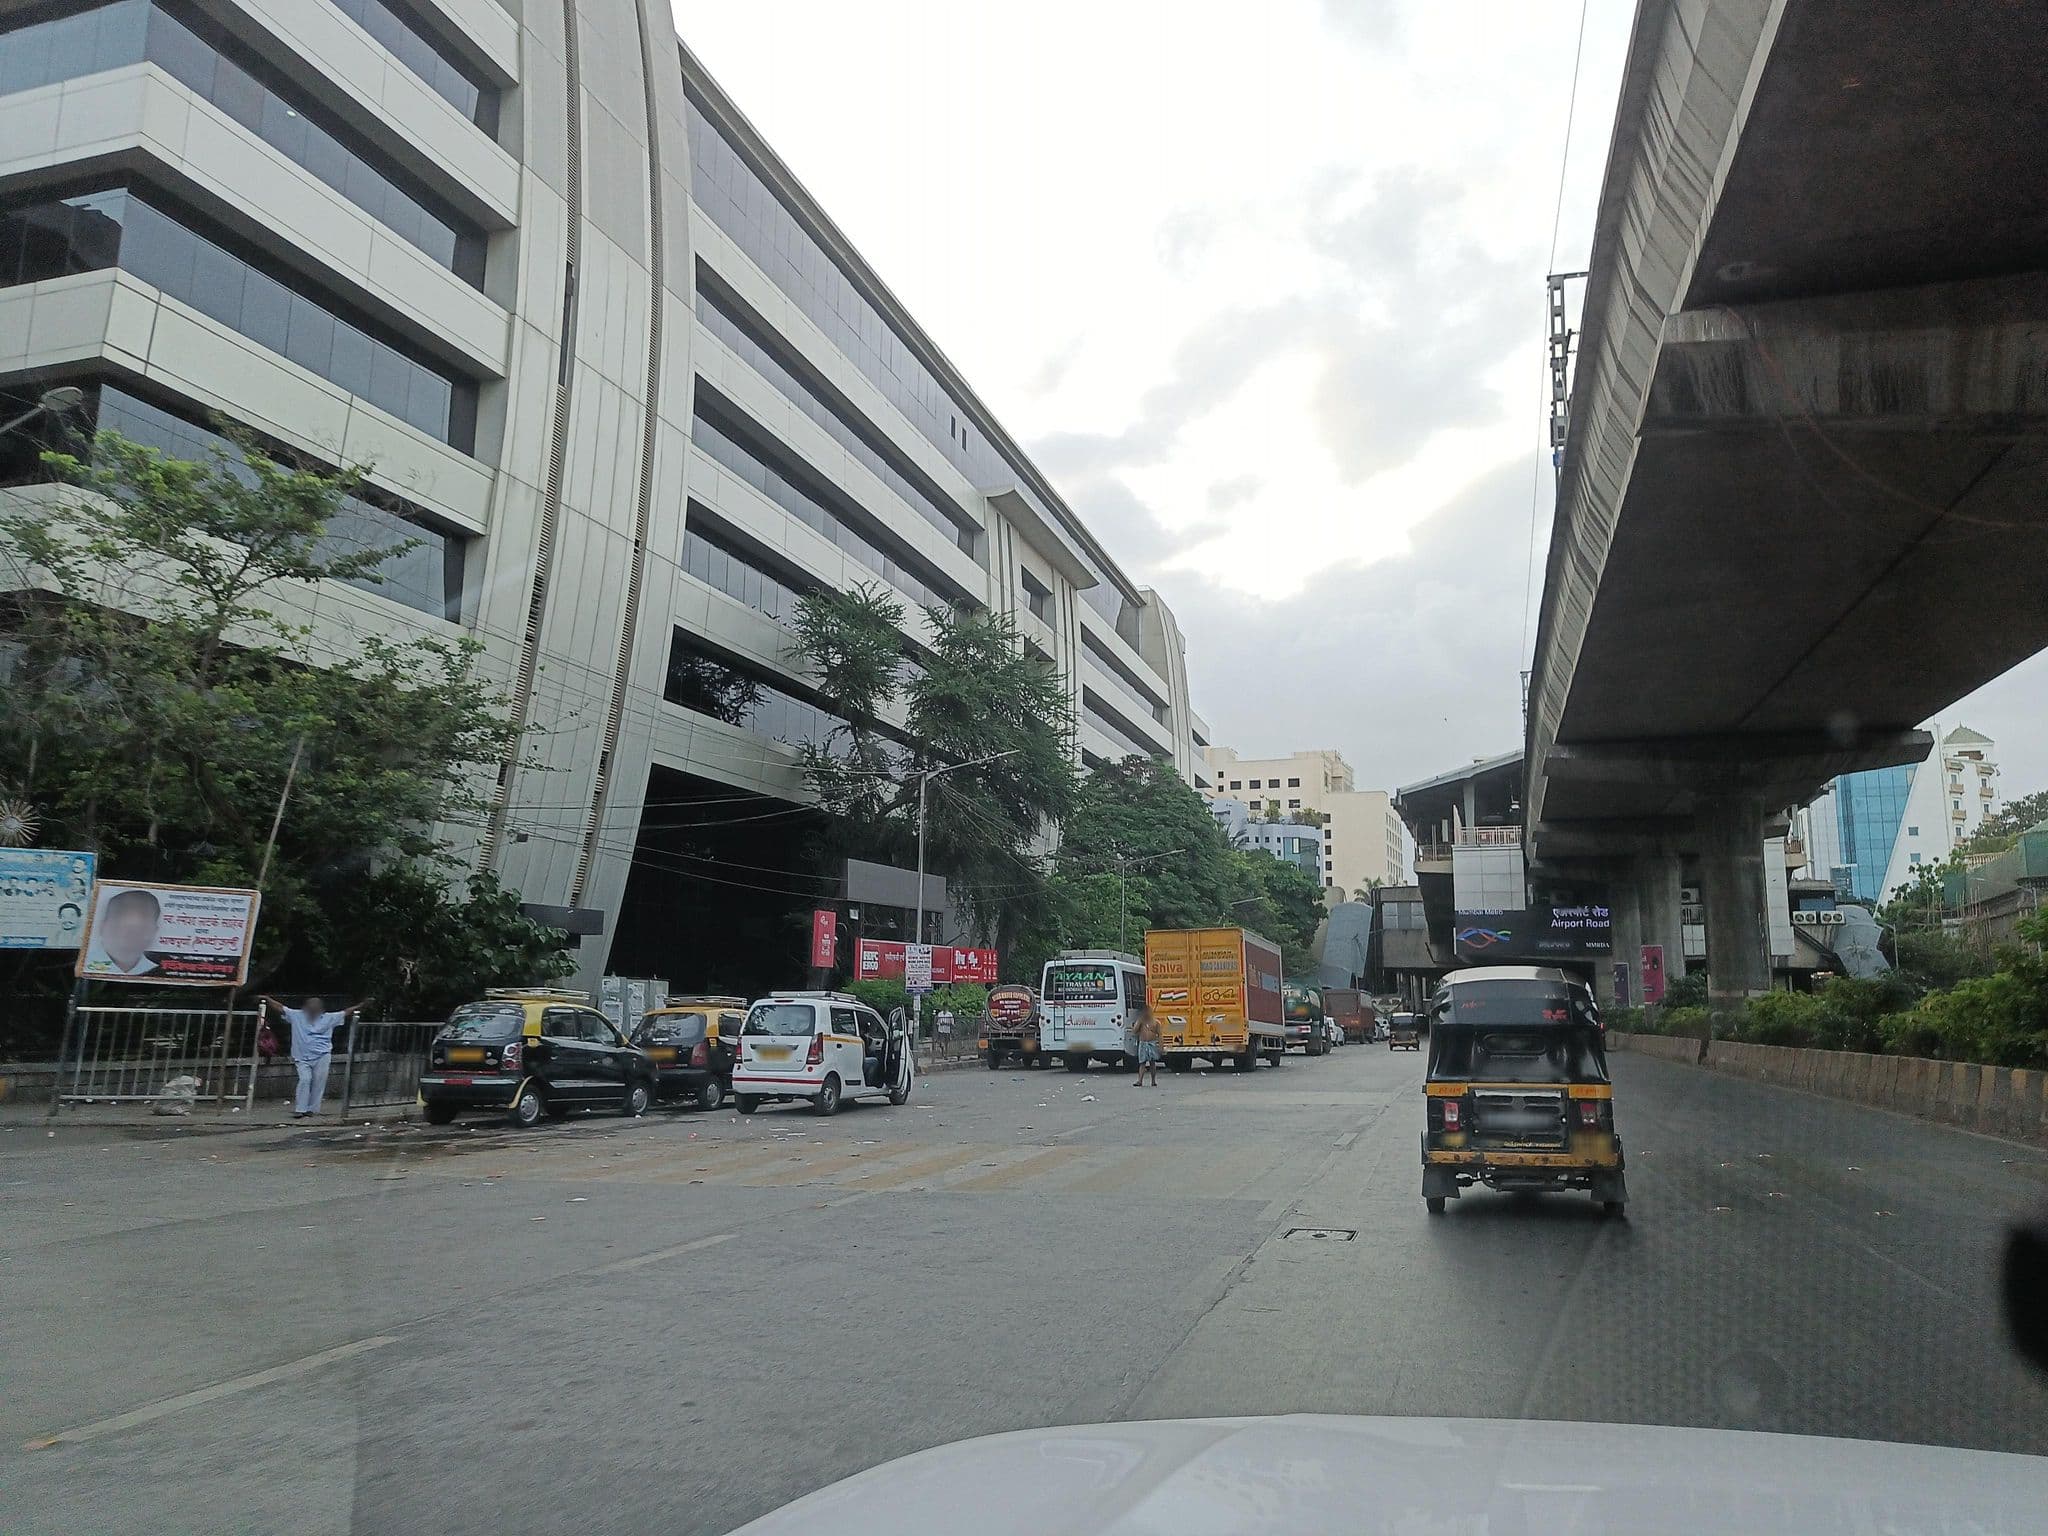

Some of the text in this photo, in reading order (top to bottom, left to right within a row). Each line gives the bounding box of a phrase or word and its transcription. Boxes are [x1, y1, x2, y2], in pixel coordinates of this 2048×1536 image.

[1551, 919, 1610, 929] Airport Road
[1055, 972, 1107, 981] AYAAN
